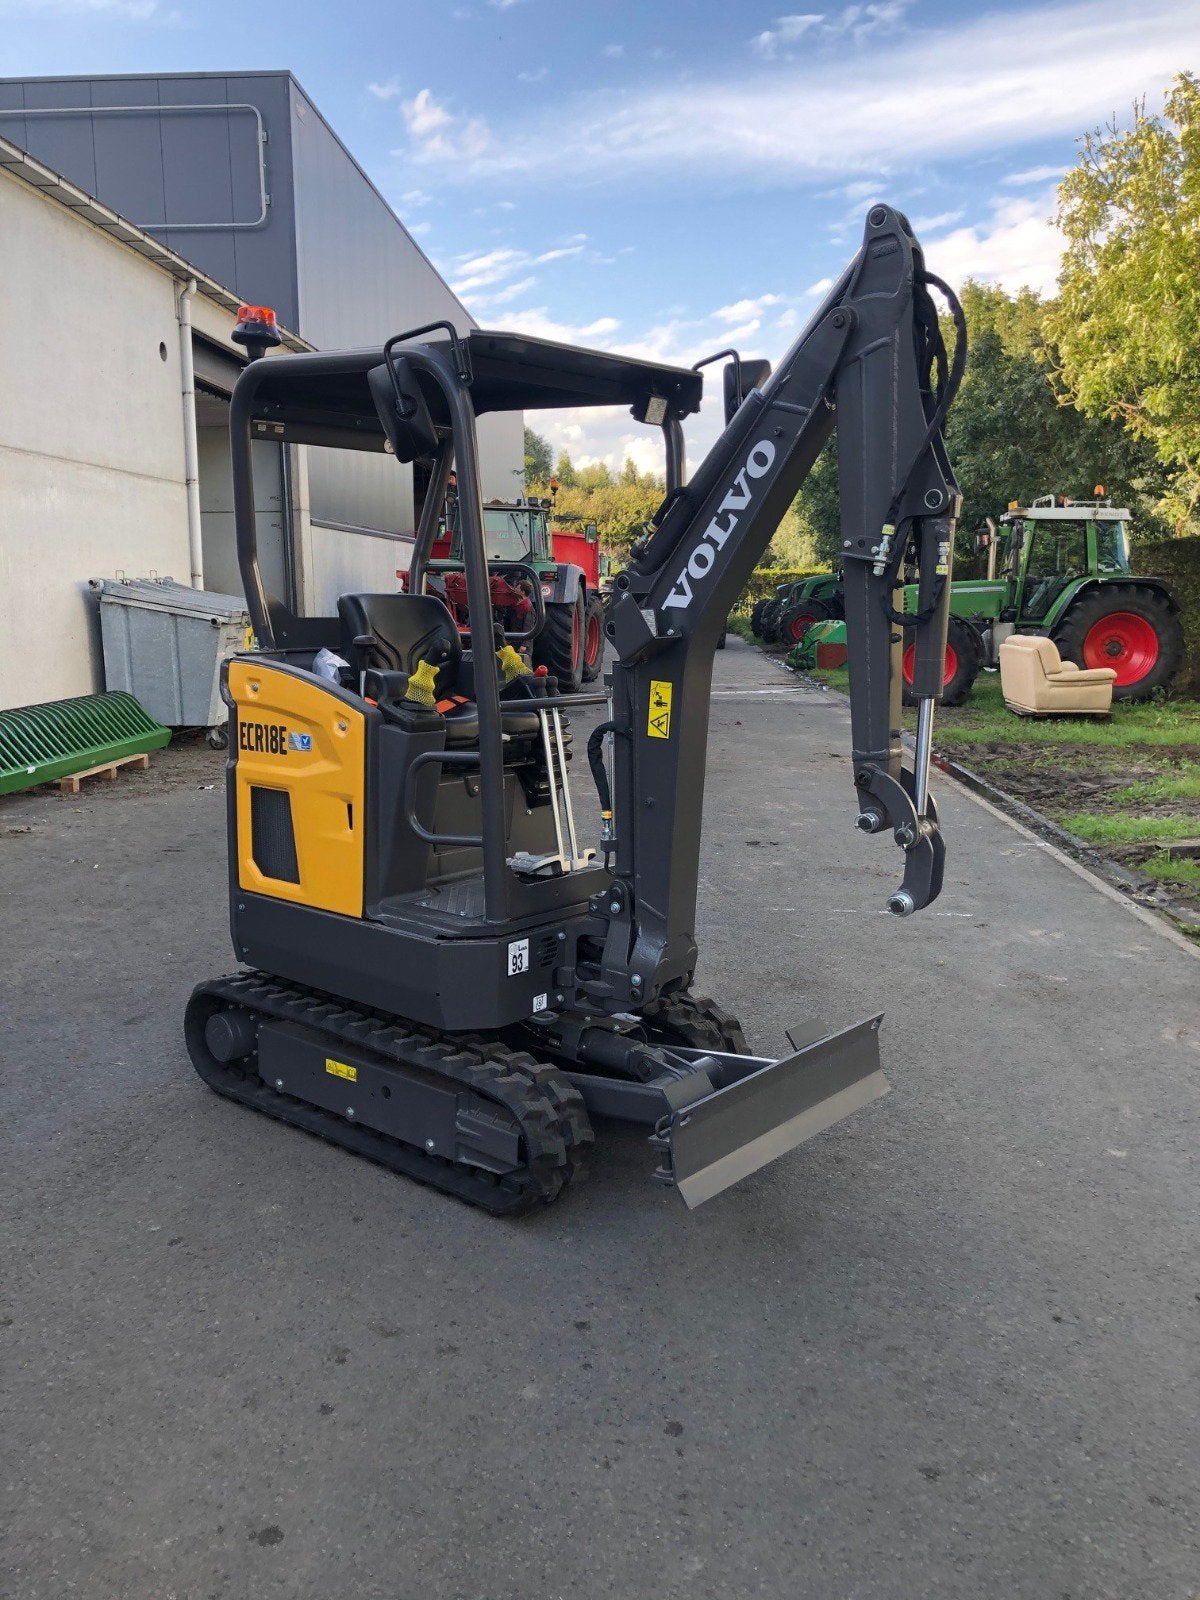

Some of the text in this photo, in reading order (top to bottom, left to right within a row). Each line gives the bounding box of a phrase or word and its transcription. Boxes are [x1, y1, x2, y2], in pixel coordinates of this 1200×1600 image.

[661, 439, 776, 611] VOLVO
[240, 721, 287, 755] ECR18E
[512, 953, 523, 973] 93
